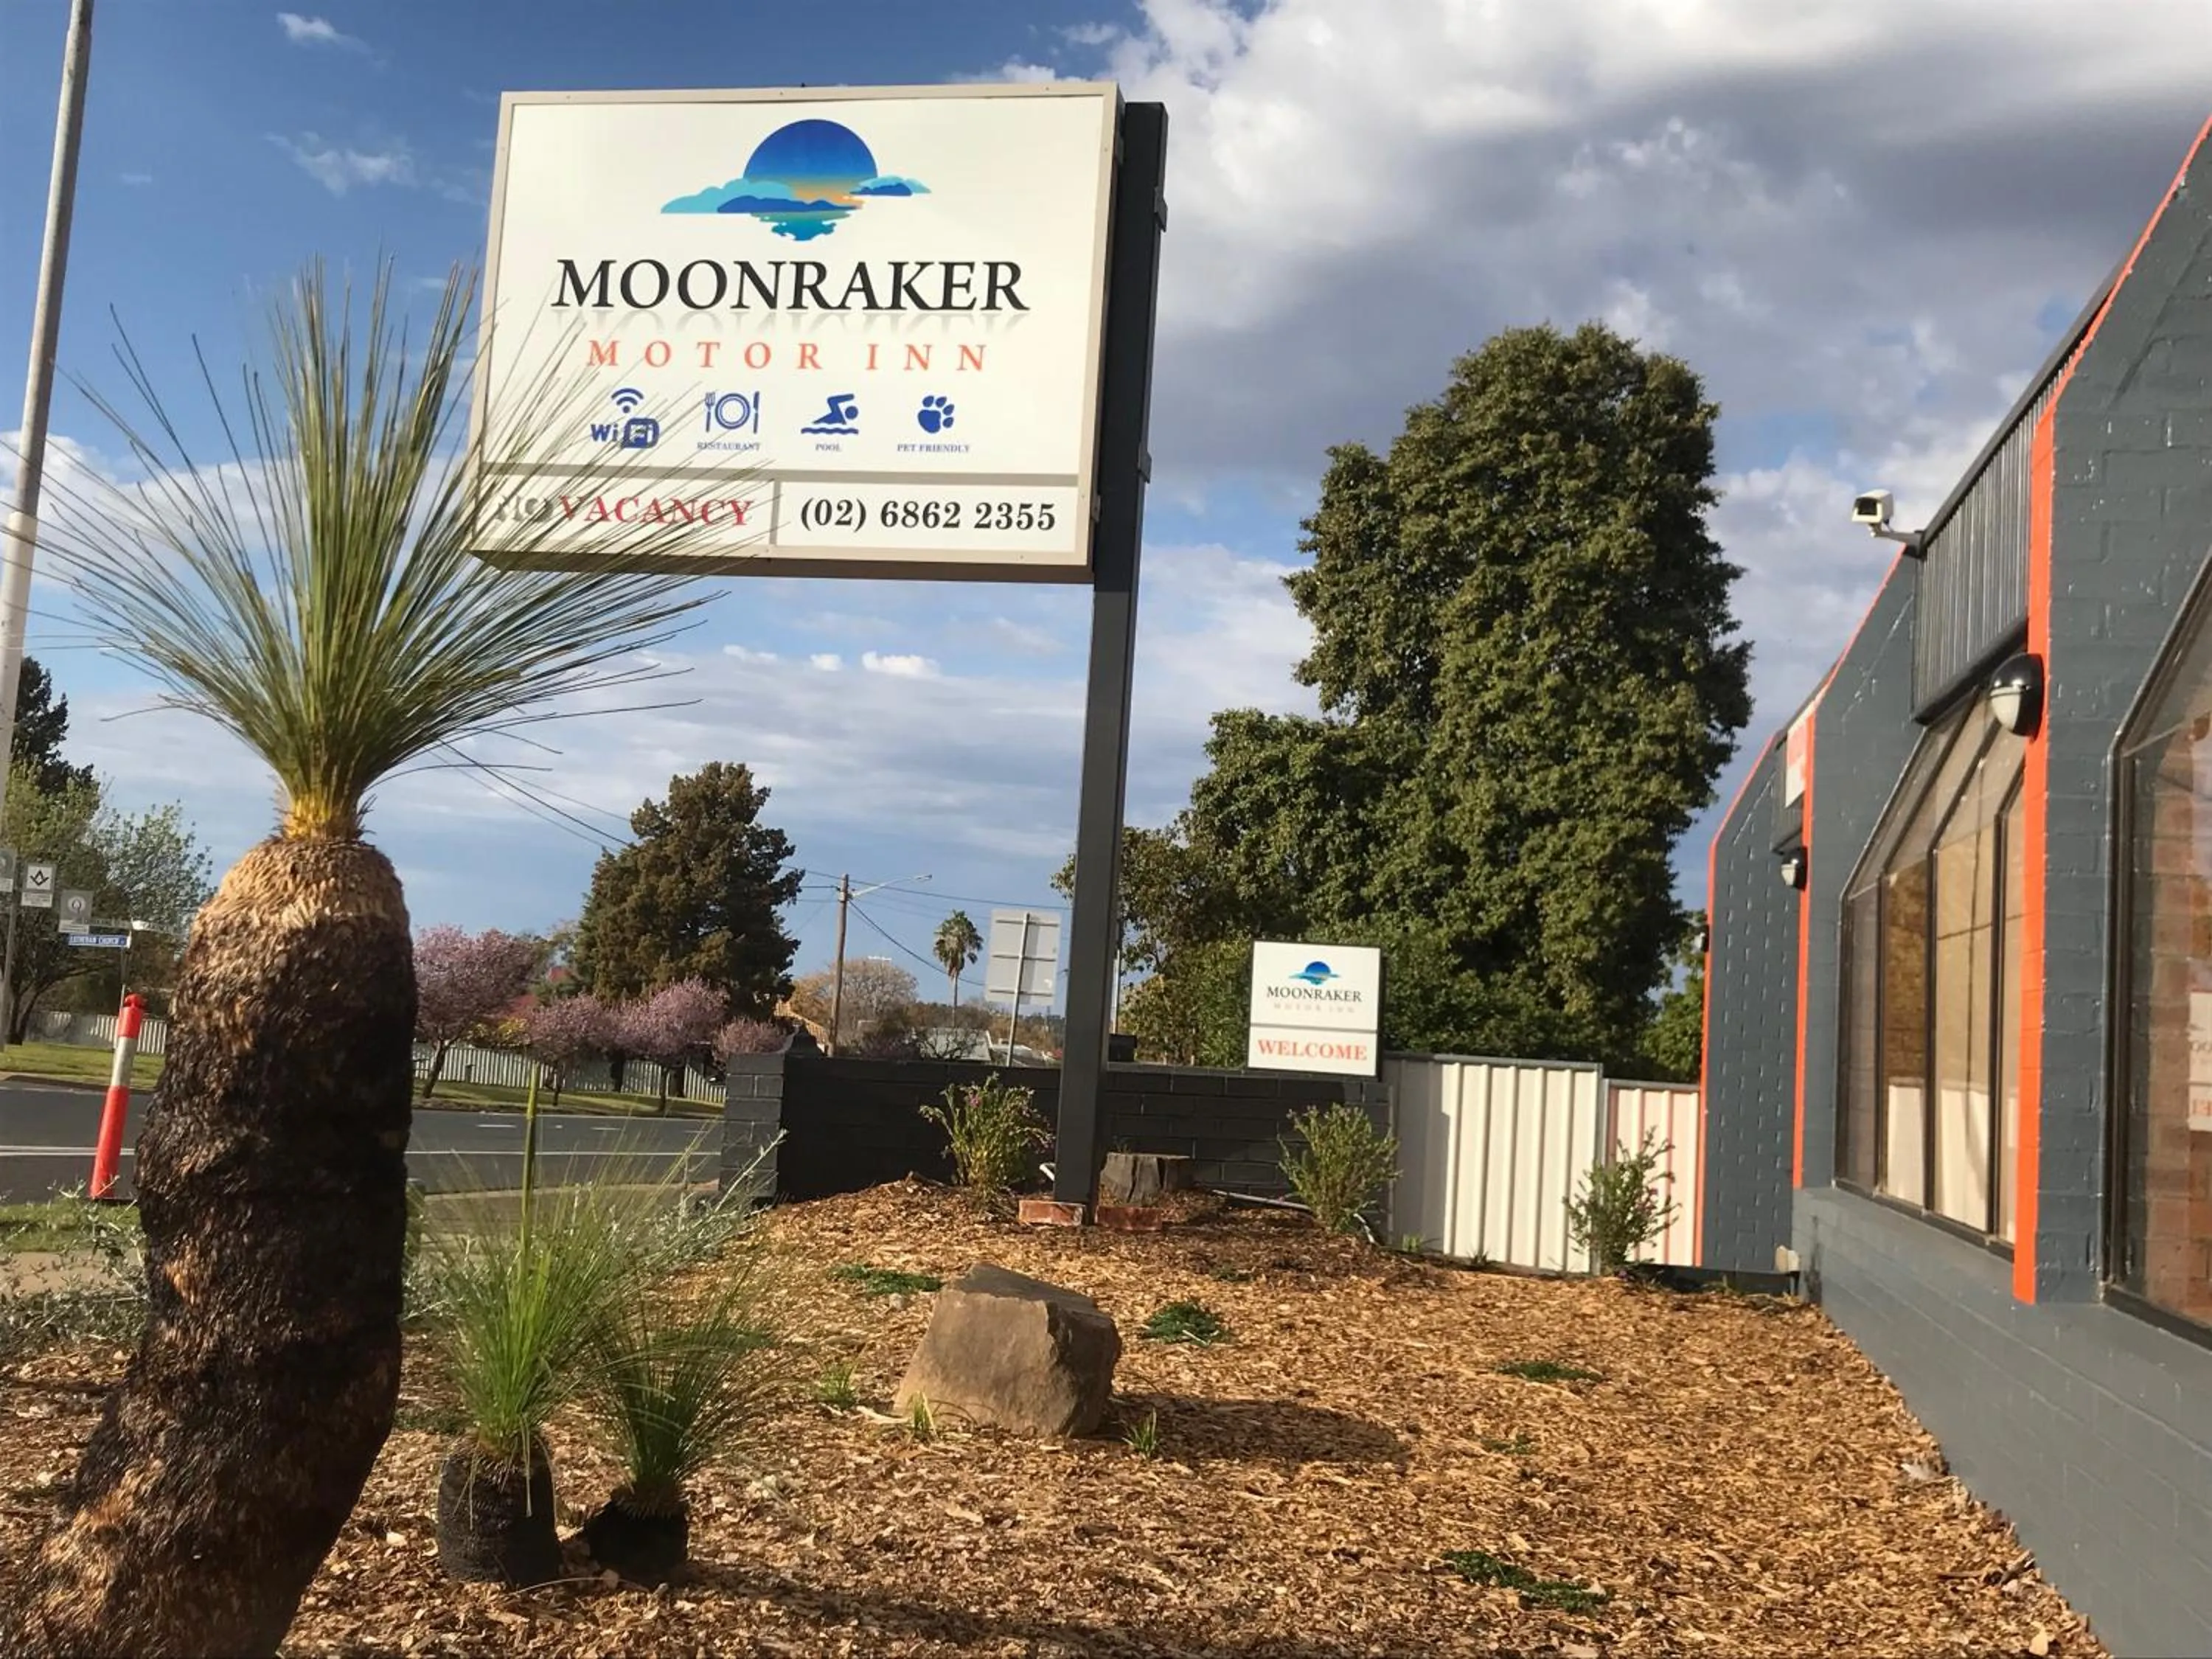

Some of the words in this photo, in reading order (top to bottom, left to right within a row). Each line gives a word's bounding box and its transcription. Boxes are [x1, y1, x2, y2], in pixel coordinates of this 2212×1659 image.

[550, 259, 1031, 311] MOONRAKER
[586, 340, 823, 370] MOTOR
[865, 344, 987, 372] INN
[697, 442, 761, 451] RESTAURANT
[815, 443, 842, 452] POOL
[897, 443, 917, 452] PET
[919, 444, 970, 453] FRIENDLY
[558, 494, 755, 526] VACANCY
[800, 497, 867, 532] (02)
[880, 500, 961, 529] 6862
[973, 501, 1056, 531] 2355
[1267, 986, 1362, 1002] MOONRAKER
[1257, 1038, 1367, 1061] WELCOME
